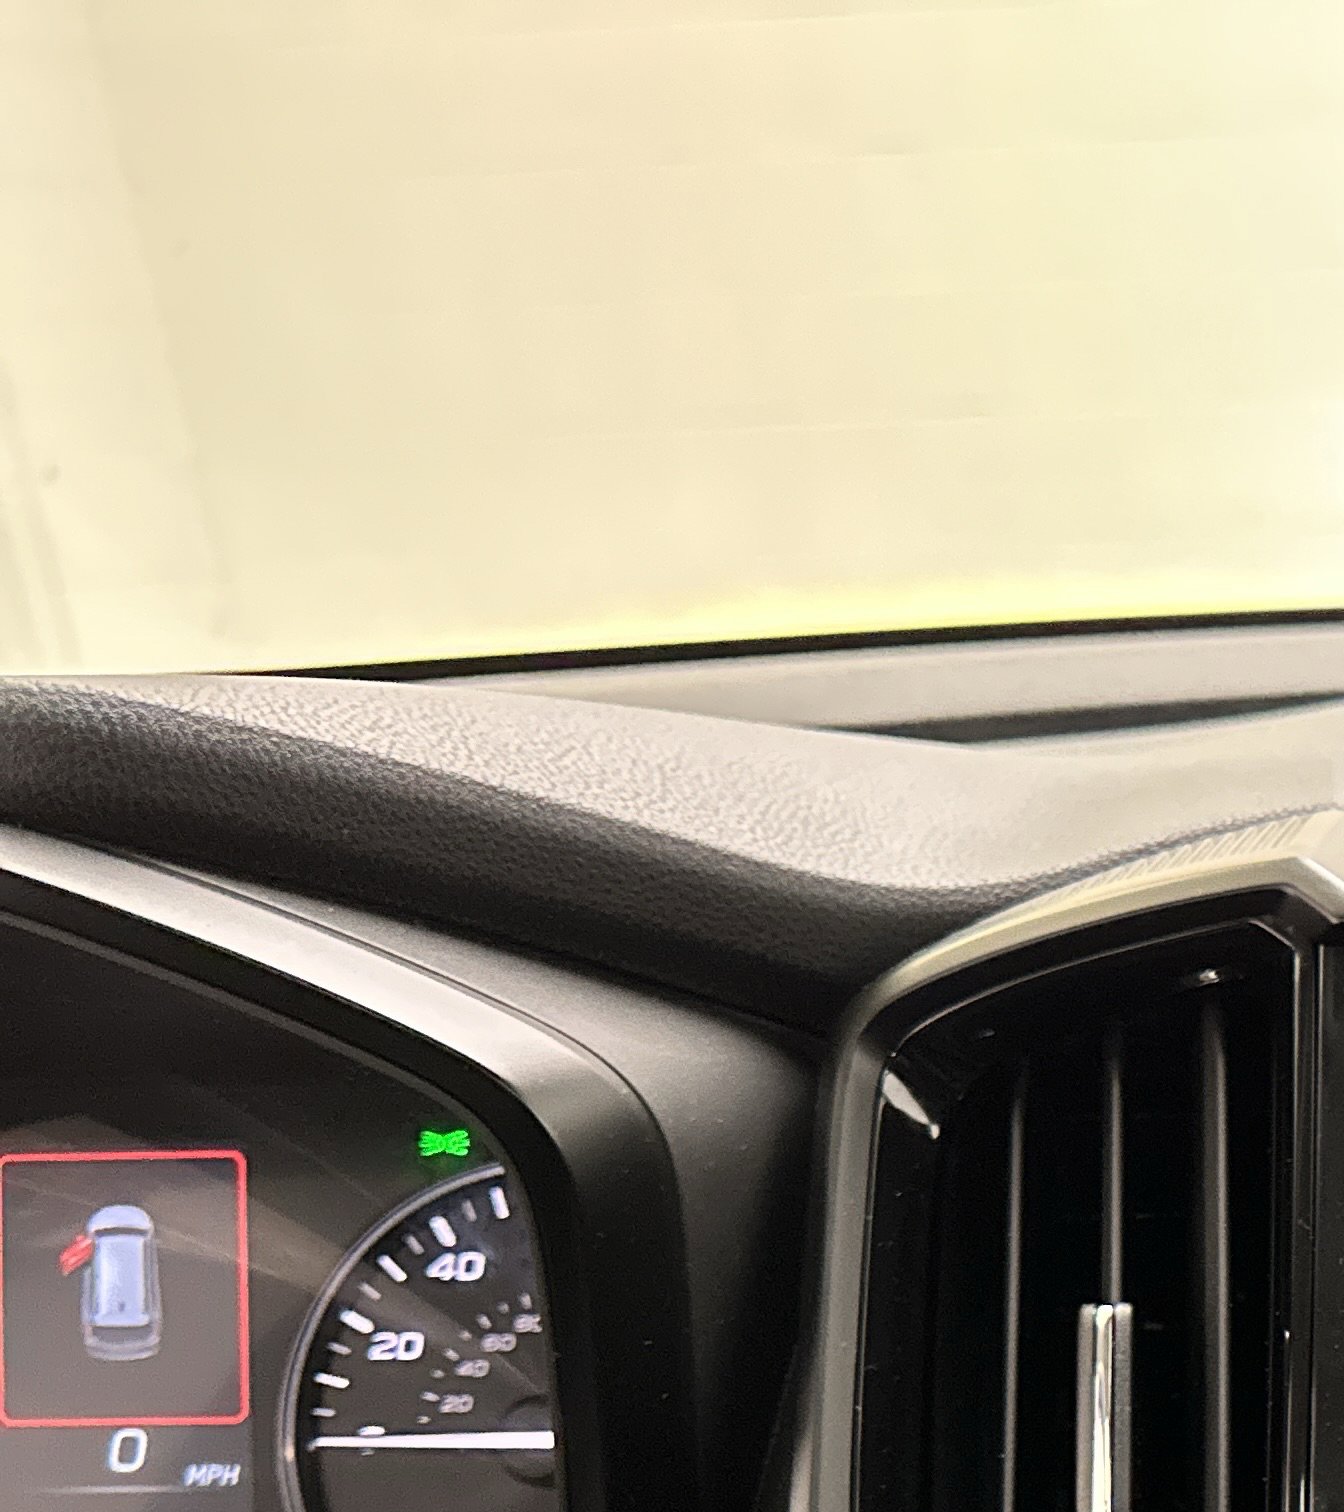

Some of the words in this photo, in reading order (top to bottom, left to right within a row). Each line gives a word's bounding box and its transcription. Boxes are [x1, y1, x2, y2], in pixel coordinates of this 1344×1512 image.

[426, 1251, 487, 1282] 40
[367, 1331, 425, 1362] 20
[182, 1463, 242, 1487] MPH
